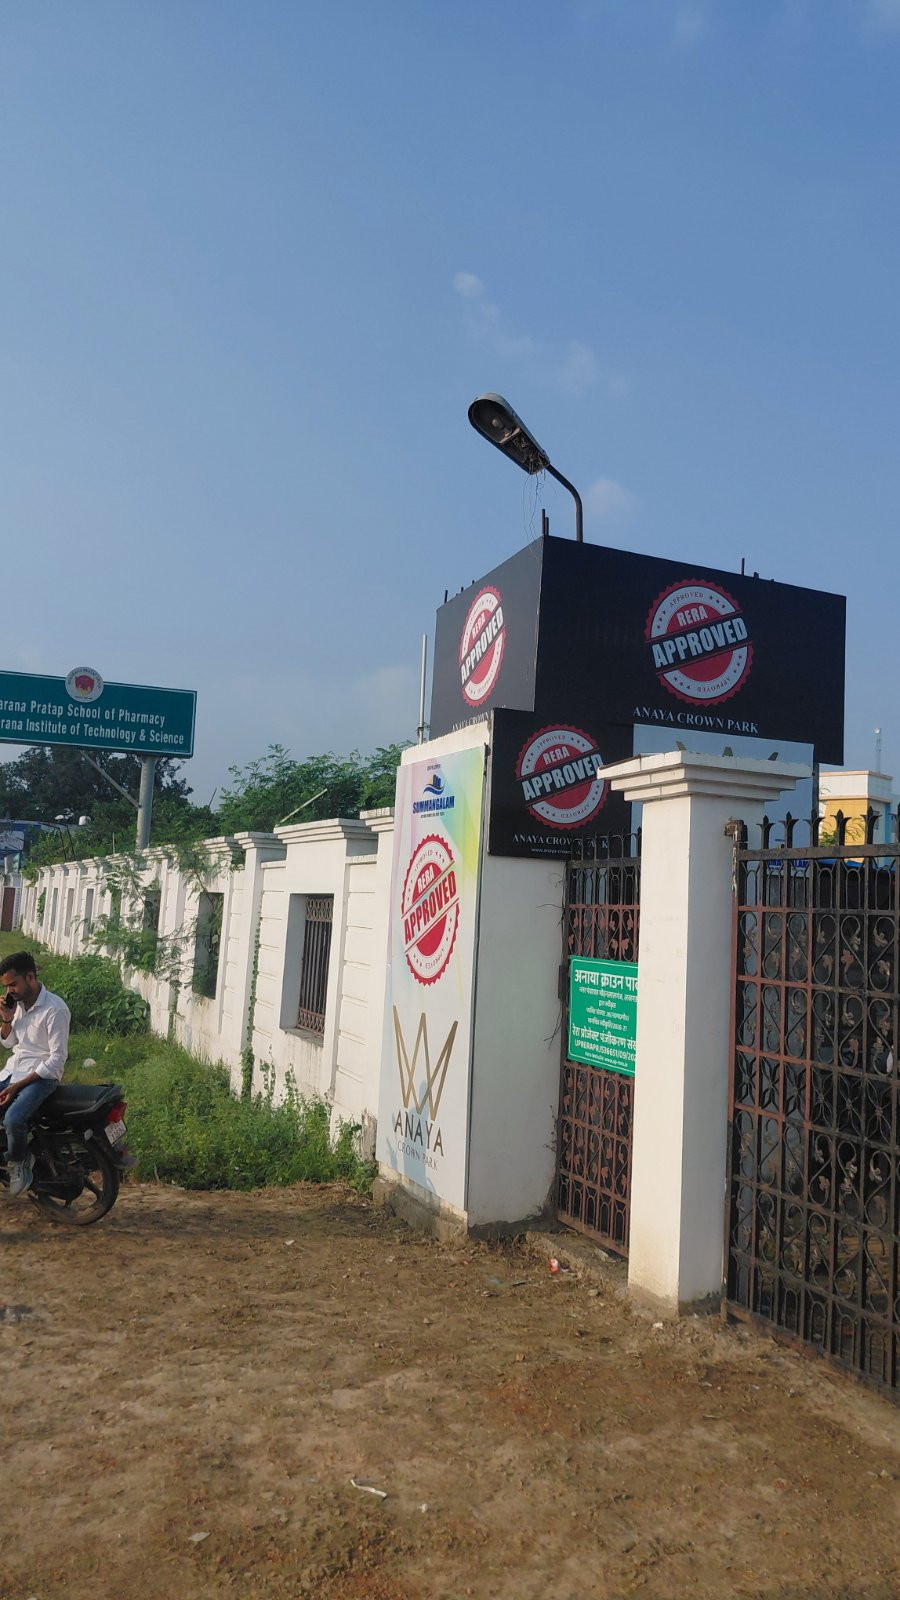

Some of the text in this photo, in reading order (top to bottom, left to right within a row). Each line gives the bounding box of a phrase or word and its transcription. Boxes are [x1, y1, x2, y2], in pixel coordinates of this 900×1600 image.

[670, 591, 704, 608] APPROVED
[471, 611, 486, 640] RERA
[677, 605, 708, 627] RERA
[461, 606, 504, 685] APPROVED
[652, 617, 748, 669] APPROVED
[31, 700, 64, 718] Pratap
[67, 703, 100, 719] School
[104, 707, 116, 720] of
[119, 708, 165, 728] Pharmacy
[633, 706, 759, 734] ANAYA CROWN PARK
[26, 718, 67, 734] Institute
[70, 722, 81, 736] of
[84, 723, 136, 743] Technology
[140, 728, 146, 742] &
[149, 729, 184, 745] Science
[543, 746, 570, 765] RERA
[522, 753, 604, 801] APPROVED
[512, 834, 543, 844] ANAYA
[417, 864, 435, 894] RERA
[404, 869, 457, 945] APPROVED
[574, 969, 600, 986] अनाया
[600, 972, 625, 990] क्राउन
[394, 1108, 444, 1157] ANAYA
[398, 1140, 438, 1171] CROWN PARK
